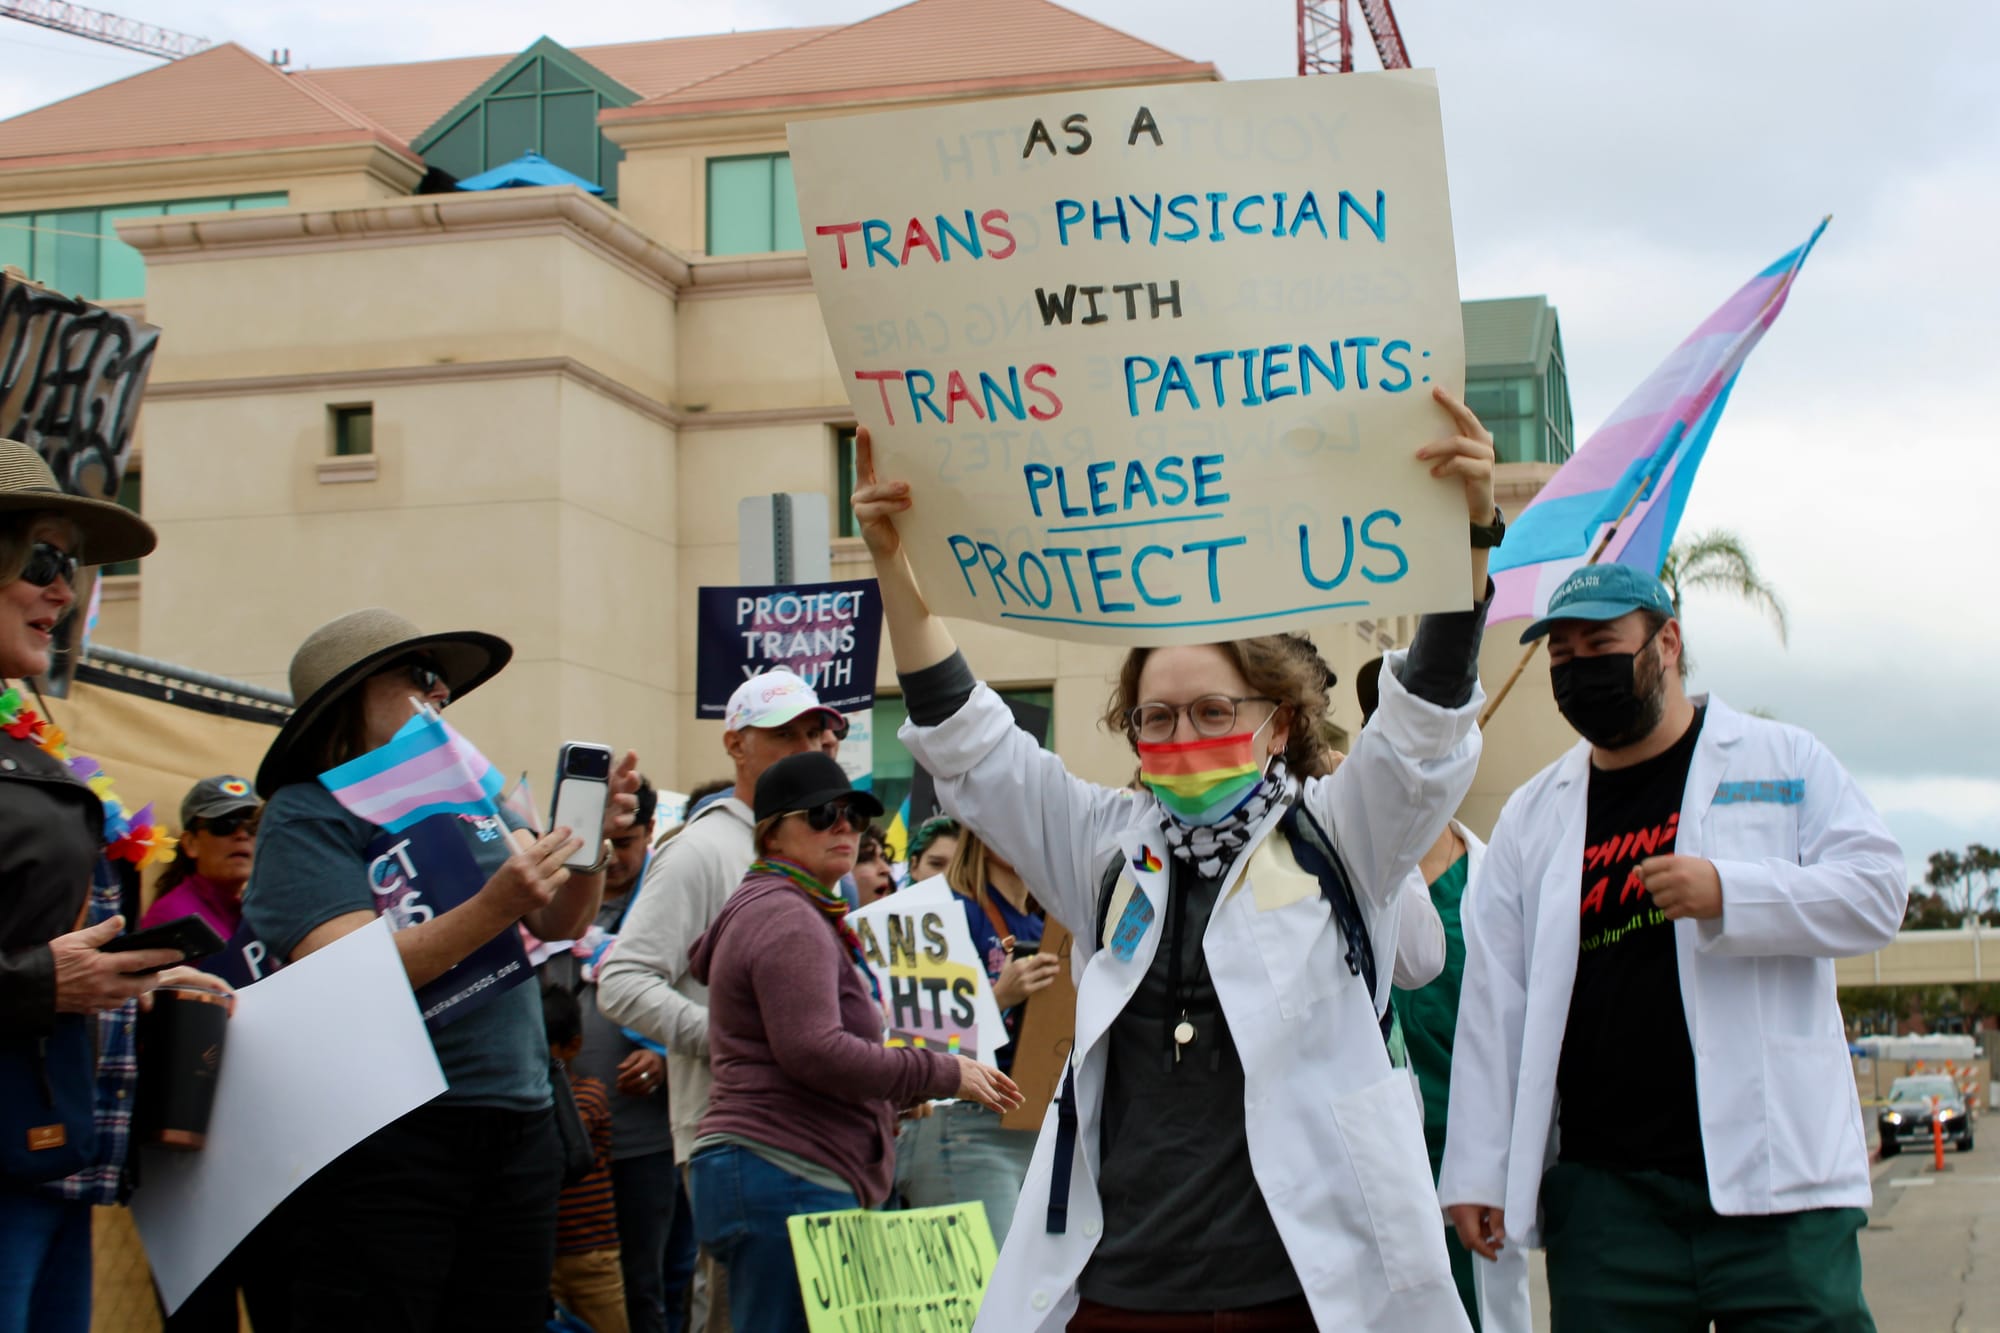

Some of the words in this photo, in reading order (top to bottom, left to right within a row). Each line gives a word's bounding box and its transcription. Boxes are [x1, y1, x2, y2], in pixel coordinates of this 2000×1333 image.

[1023, 113, 1092, 158] AS
[1128, 106, 1163, 146] A
[816, 209, 1017, 270] TRANS
[1055, 190, 1386, 246] PHYSICIAN
[1034, 280, 1182, 326] WITH
[855, 363, 1064, 427] TRANS
[1124, 336, 1431, 417] PATIENTS:
[1024, 454, 1230, 517] PLEASE
[947, 535, 1247, 613] PROTECT
[1299, 509, 1409, 591] US
[736, 590, 864, 625] PROTECT
[741, 625, 856, 659] TRANS
[741, 658, 853, 689] YUTH
[857, 911, 950, 969] ANS
[889, 975, 976, 1030] HTS
